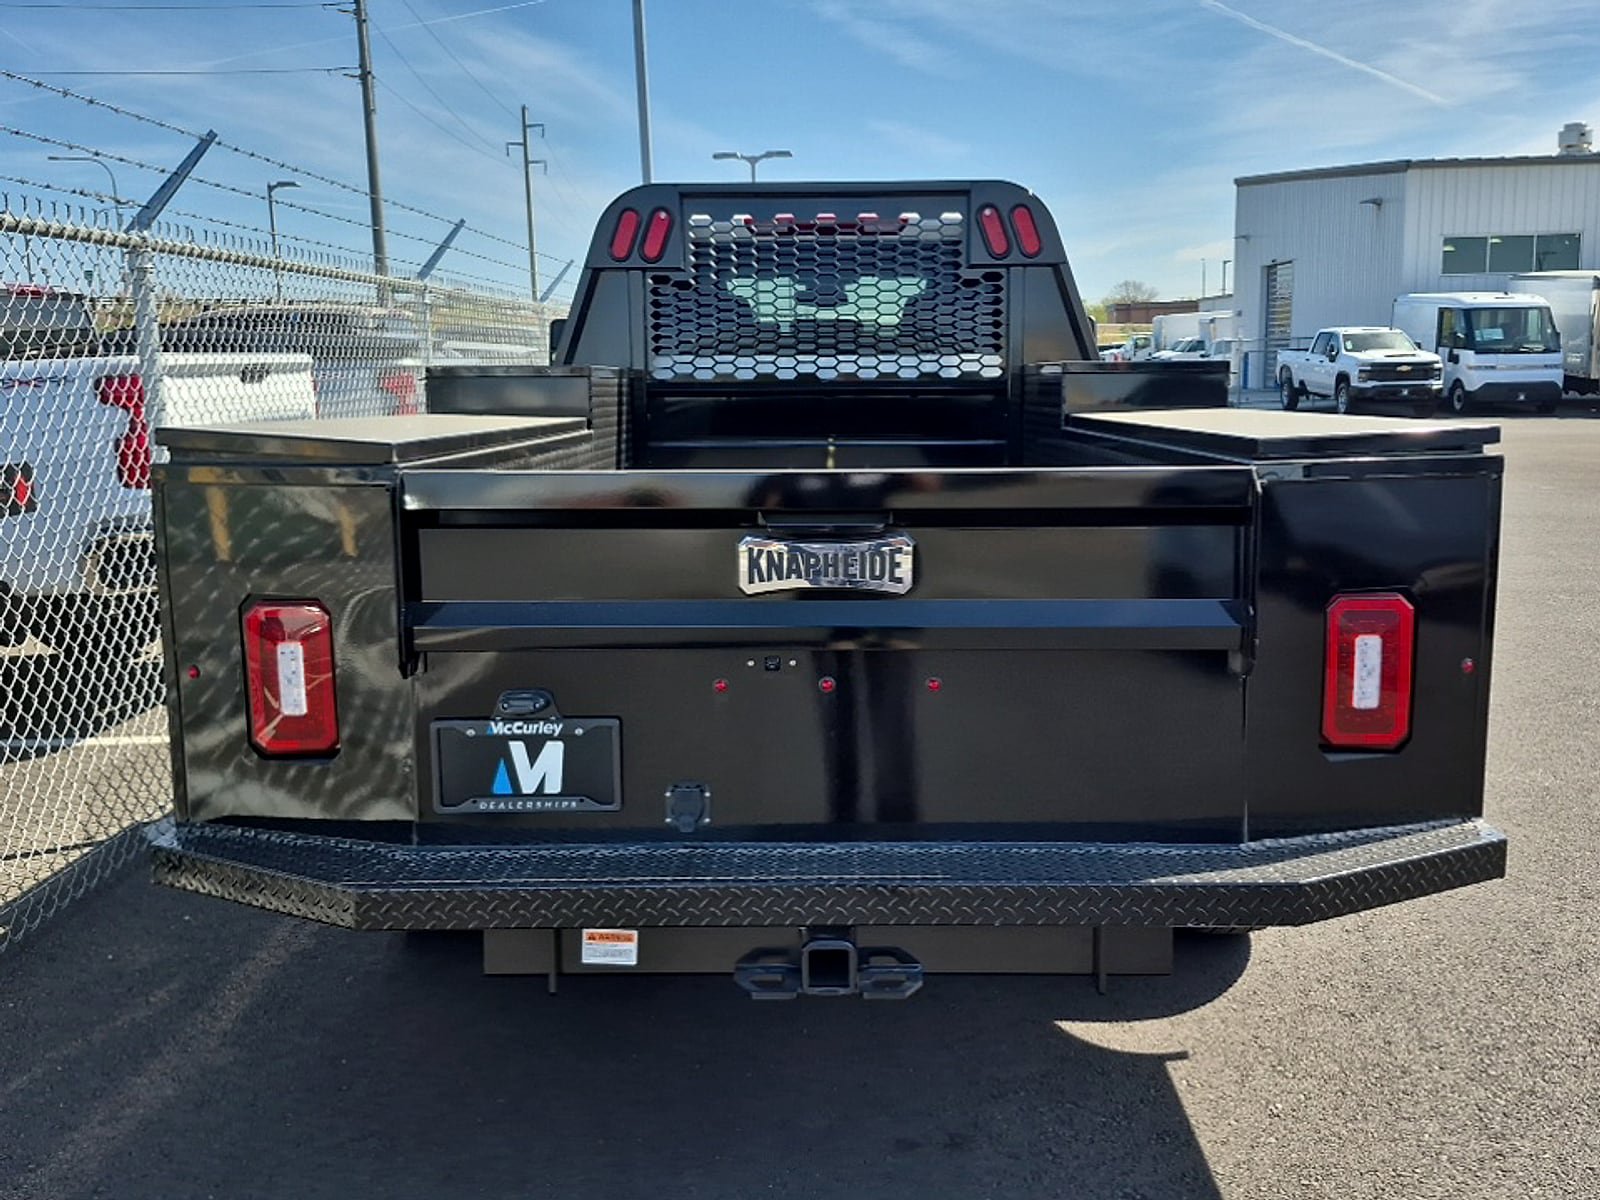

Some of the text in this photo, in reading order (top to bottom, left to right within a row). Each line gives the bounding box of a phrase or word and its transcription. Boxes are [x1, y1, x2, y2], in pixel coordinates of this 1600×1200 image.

[748, 547, 903, 584] KNAPHEIDE
[487, 721, 563, 737] McCurley
[479, 800, 578, 810] DEALERSHIPS
